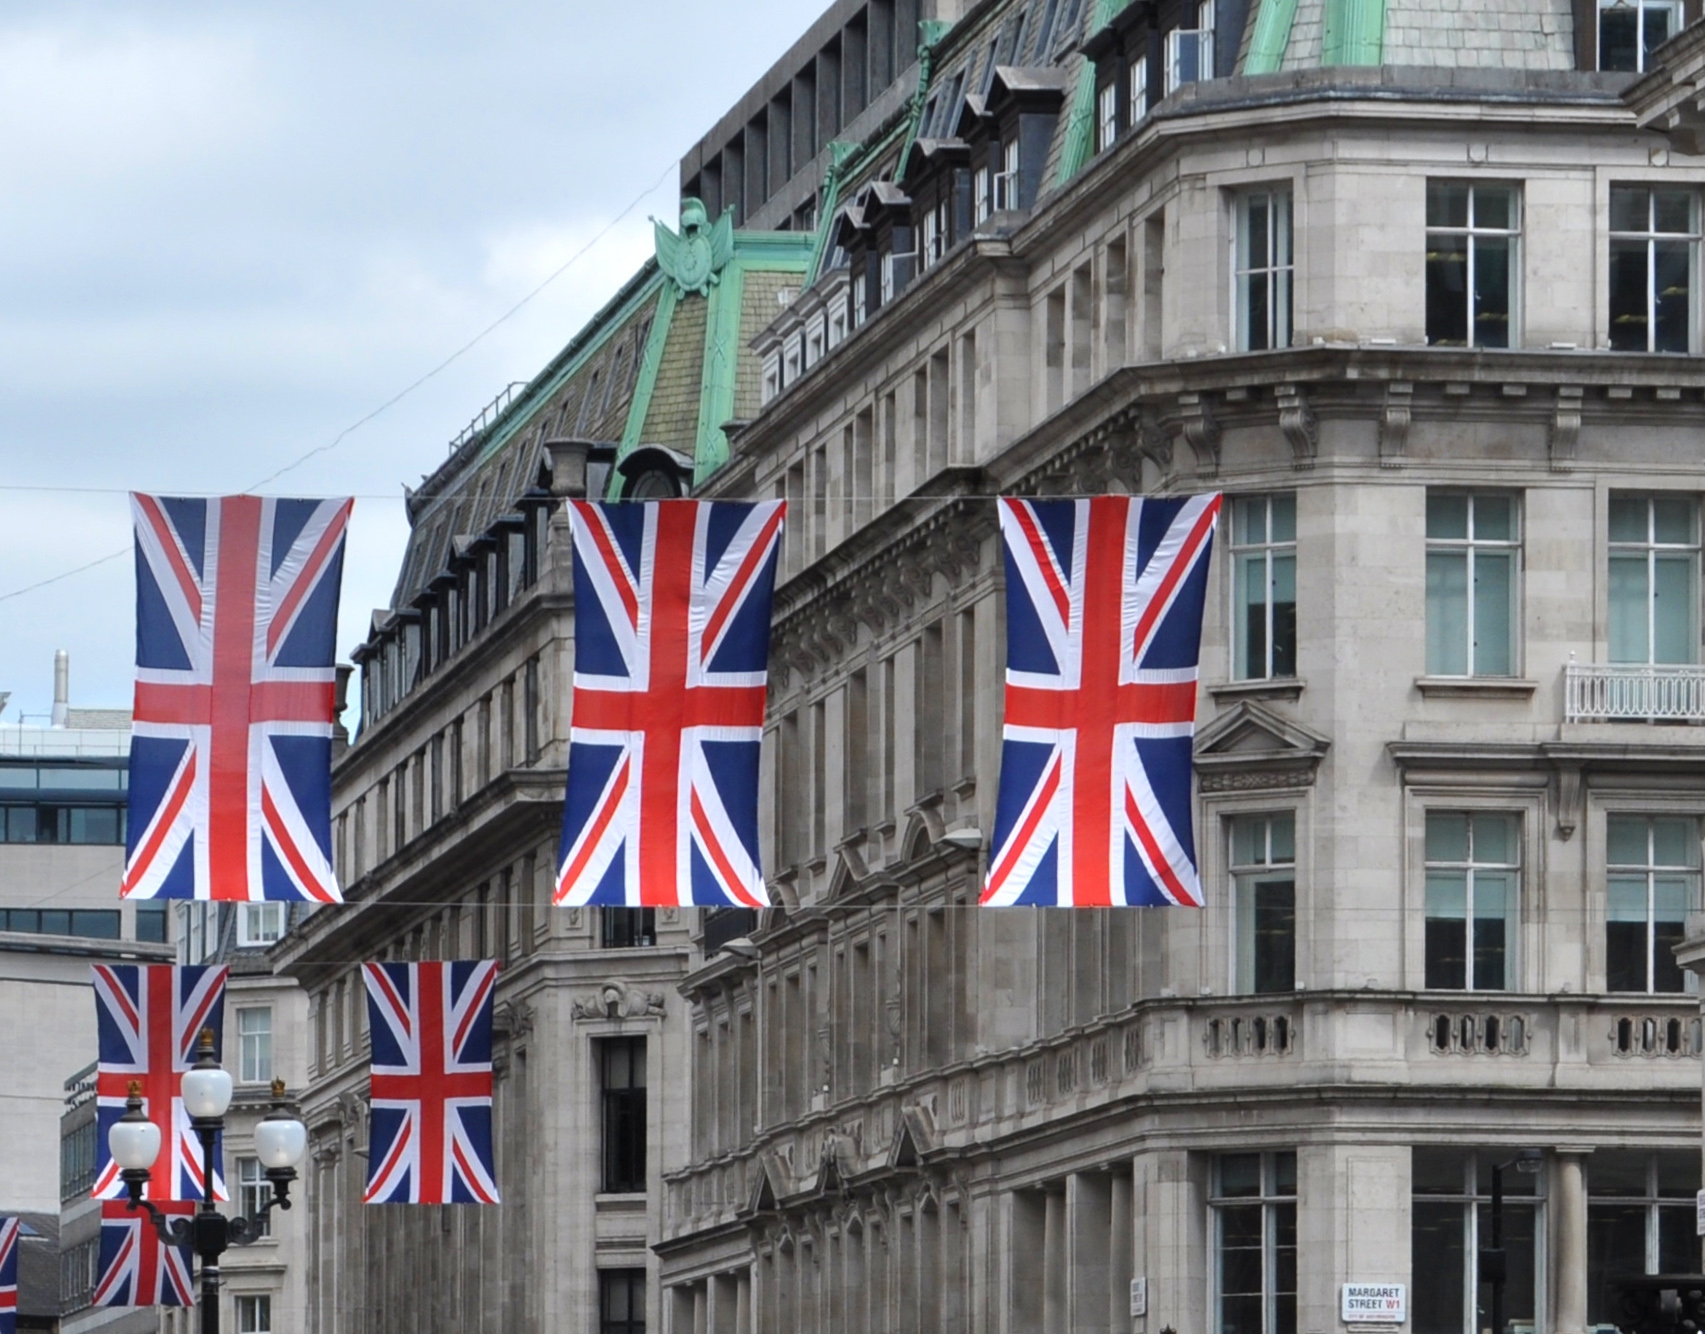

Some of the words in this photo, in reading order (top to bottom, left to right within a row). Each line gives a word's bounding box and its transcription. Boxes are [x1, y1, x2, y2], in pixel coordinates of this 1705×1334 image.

[1348, 1287, 1400, 1298] MARGARET
[1348, 1299, 1383, 1310] STREET
[1385, 1300, 1400, 1310] W1
